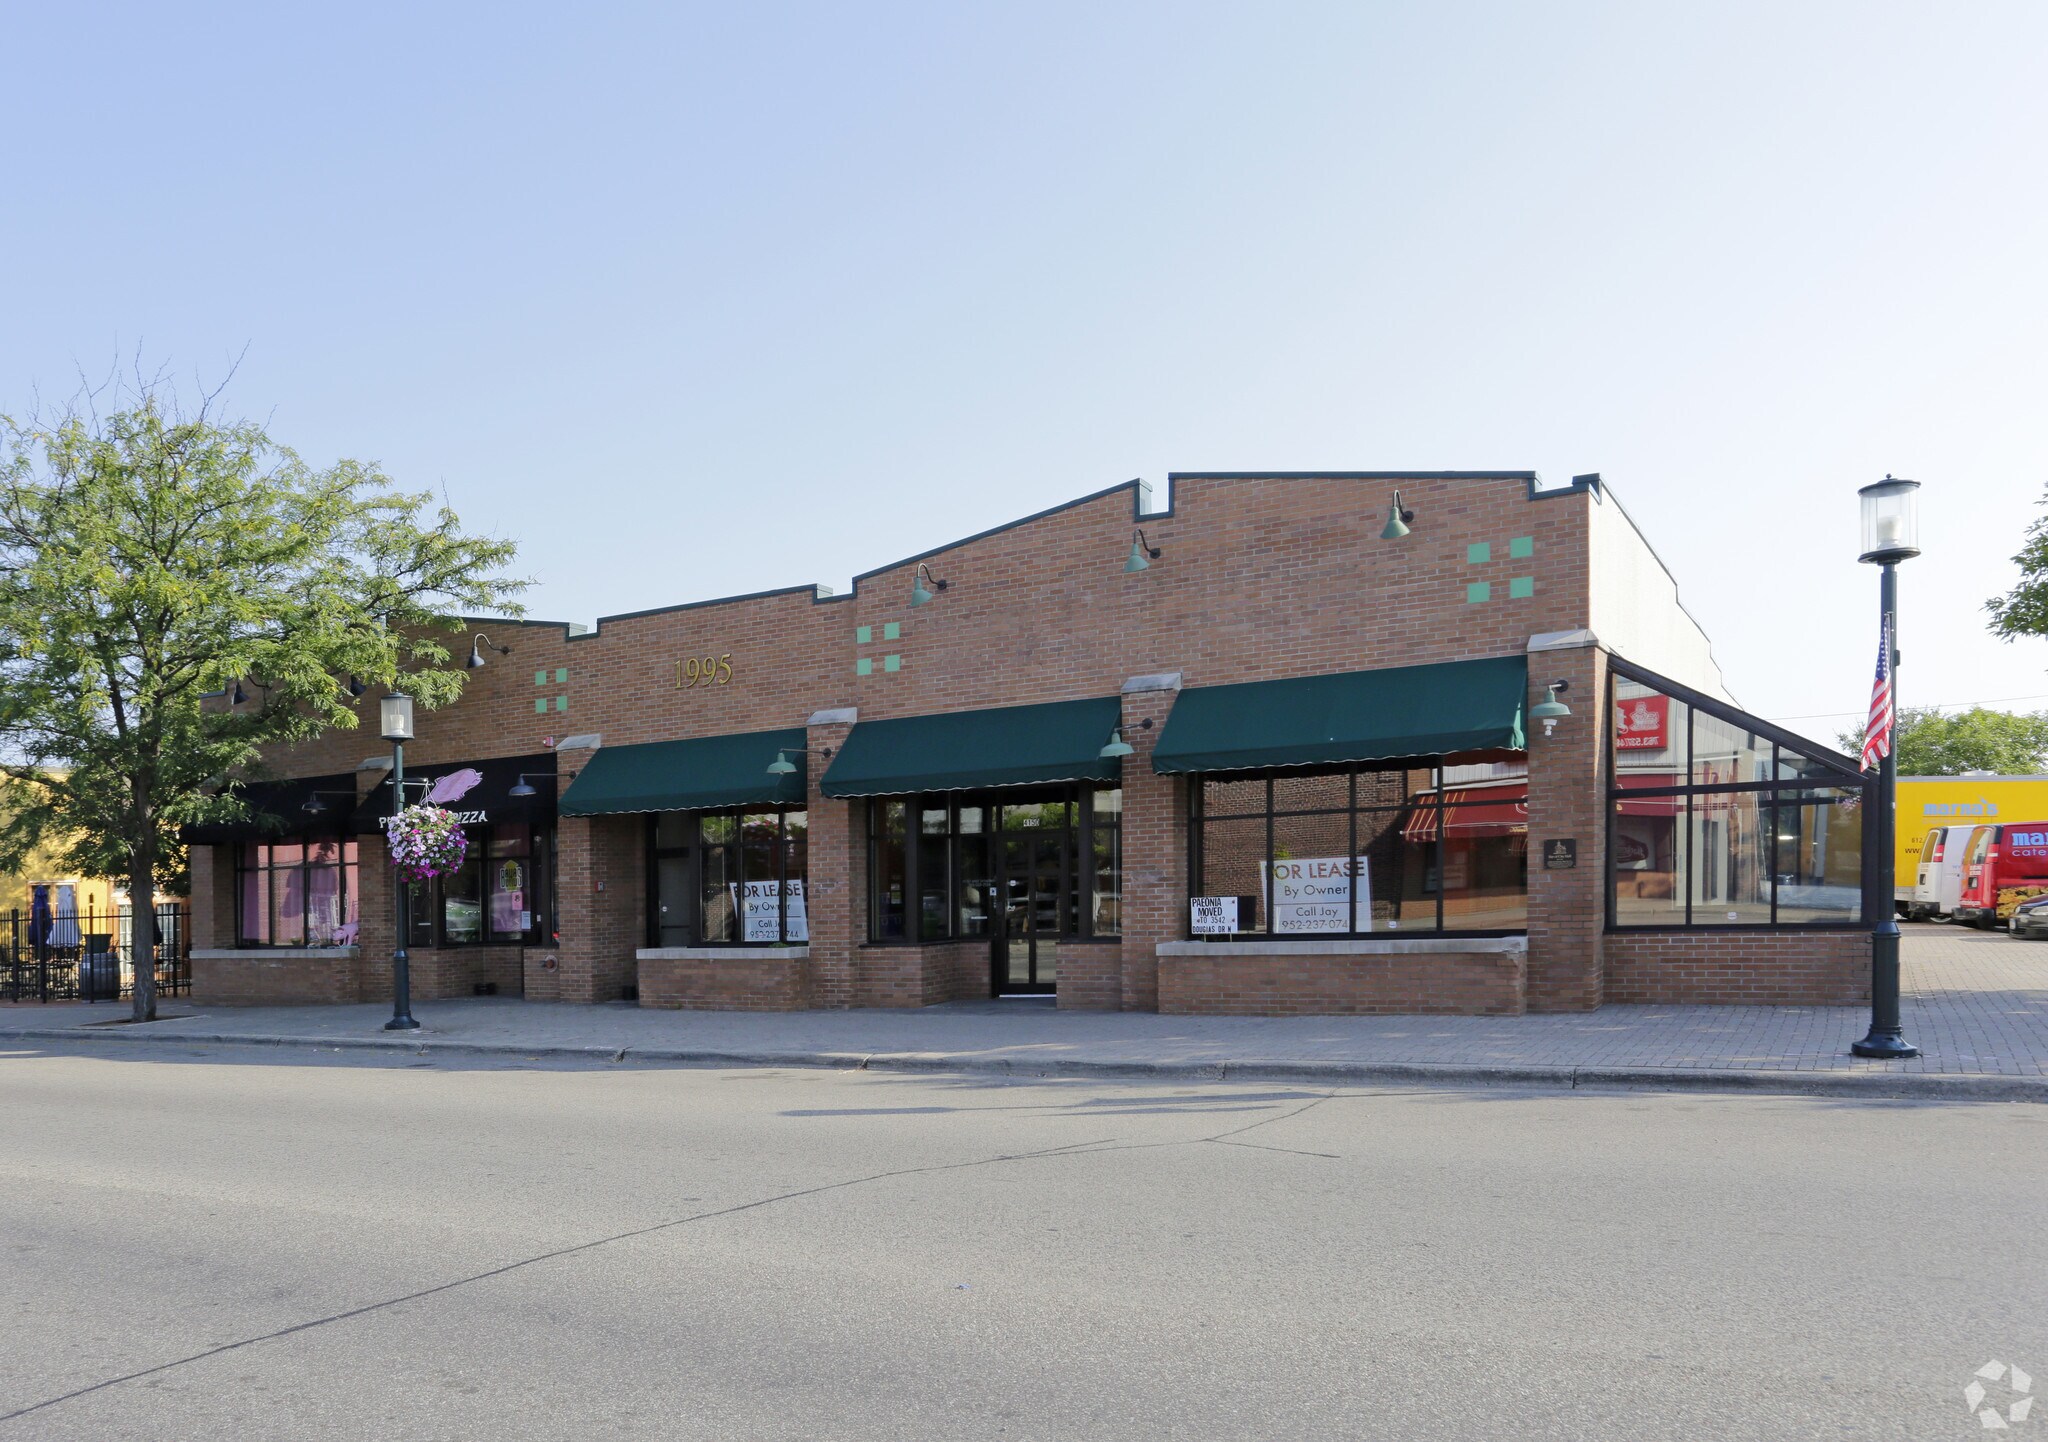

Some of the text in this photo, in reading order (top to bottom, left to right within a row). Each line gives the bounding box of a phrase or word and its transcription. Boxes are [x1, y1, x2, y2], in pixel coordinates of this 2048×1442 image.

[674, 653, 732, 688] 1995
[2012, 832, 2048, 846] ma
[1265, 864, 1302, 880] OR
[1284, 884, 1348, 899] By Owner
[749, 902, 759, 913] By
[1192, 897, 1222, 907] PAEONIA
[1198, 907, 1223, 917] MOVED
[1295, 907, 1338, 918] Call Jay
[758, 919, 772, 928] Call
[1211, 916, 1226, 924] 3542
[1281, 919, 1349, 930] 952-237-074
